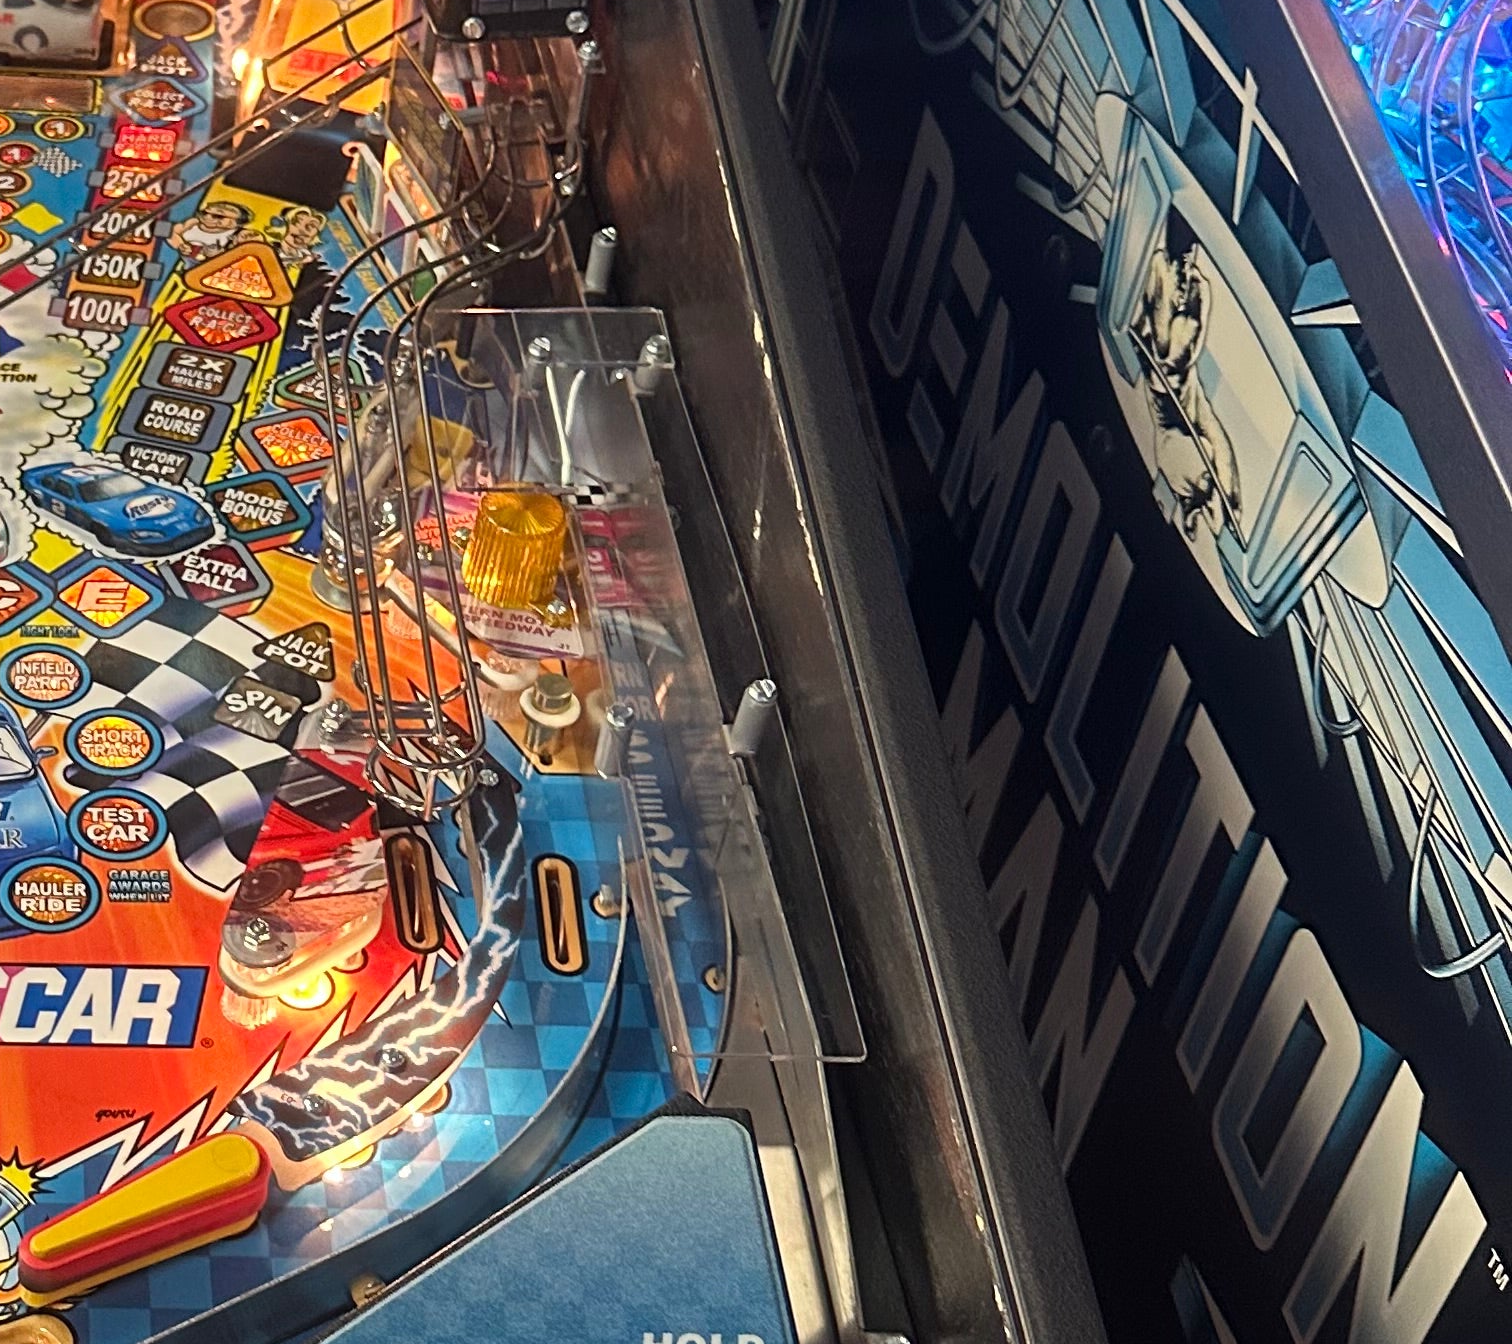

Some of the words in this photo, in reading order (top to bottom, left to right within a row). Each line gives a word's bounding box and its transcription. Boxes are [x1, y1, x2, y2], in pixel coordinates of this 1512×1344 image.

[68, 296, 132, 327] 100K
[198, 306, 253, 324] COLLECT
[177, 355, 228, 373] 2X
[167, 365, 226, 385] HAULER
[171, 376, 214, 391] MILES
[149, 399, 206, 422] ROAD
[142, 413, 202, 438] COURSE
[129, 446, 185, 468] VICTORY
[131, 457, 176, 477] LAP
[223, 487, 289, 512] MODE
[220, 497, 285, 525] BONUS
[183, 554, 248, 582] EXTRA
[180, 568, 237, 594] BALL
[76, 580, 131, 612] E
[278, 633, 331, 662] JACK
[14, 660, 76, 676] INFIELD
[263, 644, 329, 676] POT
[14, 675, 79, 692] PARTY
[224, 689, 293, 727] SPIN
[80, 728, 146, 744] SHORT
[82, 742, 146, 758] TRACK
[85, 806, 151, 824] TEST
[85, 823, 151, 844] CAR
[13, 881, 87, 898] HAULER
[20, 897, 82, 913] RIDE
